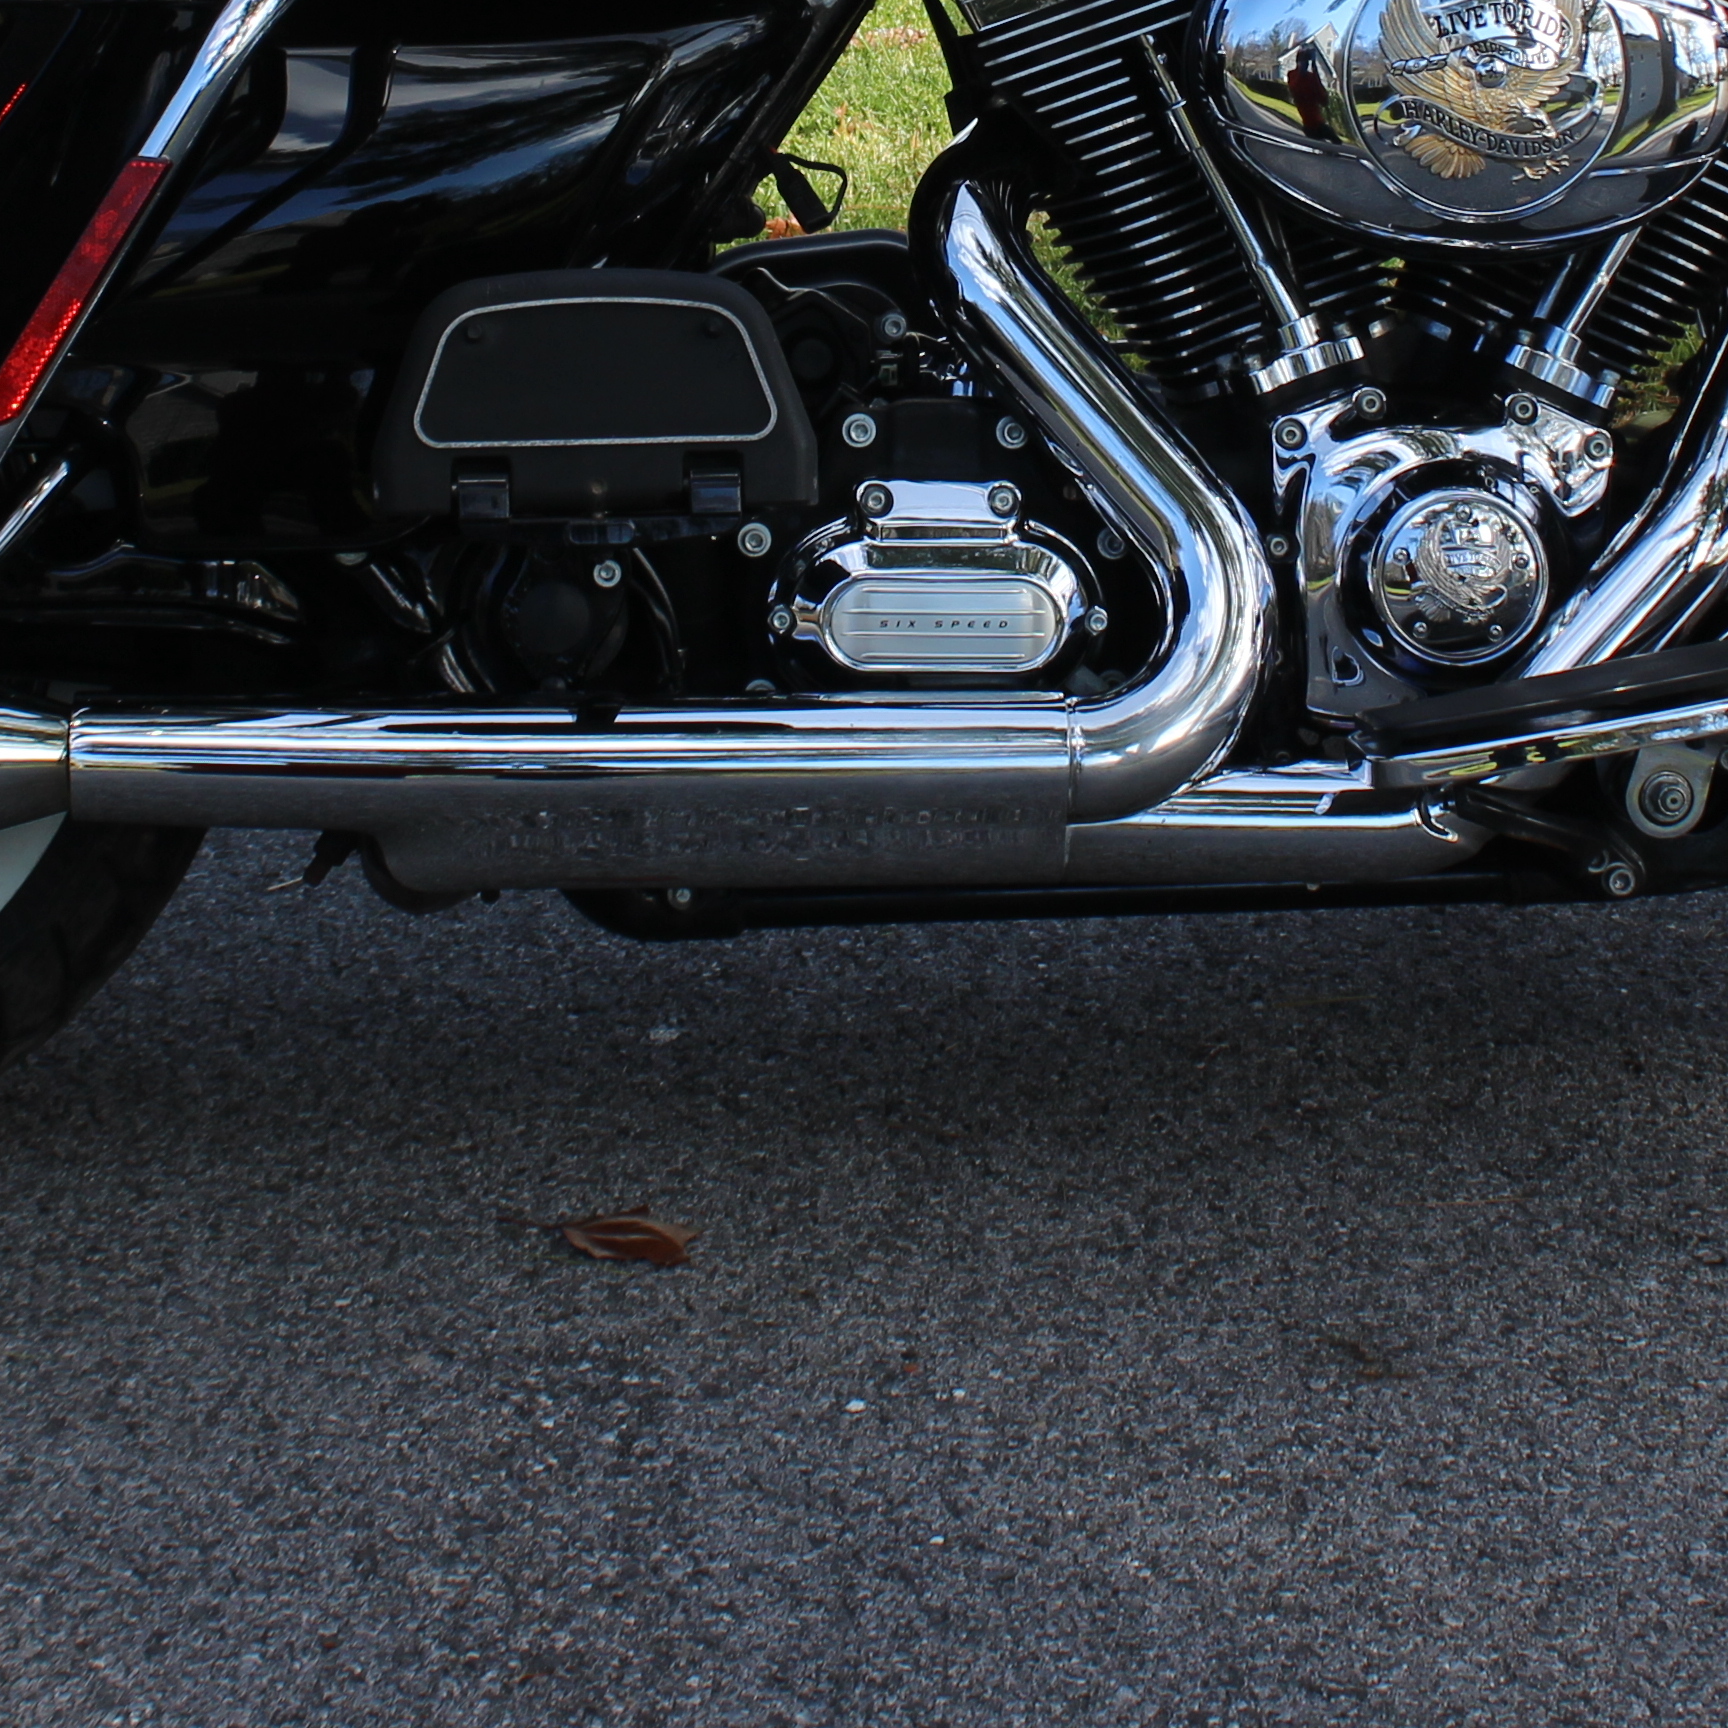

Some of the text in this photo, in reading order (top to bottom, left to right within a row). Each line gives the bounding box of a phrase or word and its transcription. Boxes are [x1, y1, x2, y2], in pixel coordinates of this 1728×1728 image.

[1433, 1, 1572, 48] LIVE TO RIDE
[1472, 42, 1506, 57] RIDE
[1400, 99, 1577, 158] HARLEY-DAVIDSON
[879, 619, 1009, 629] SIX SPEED
